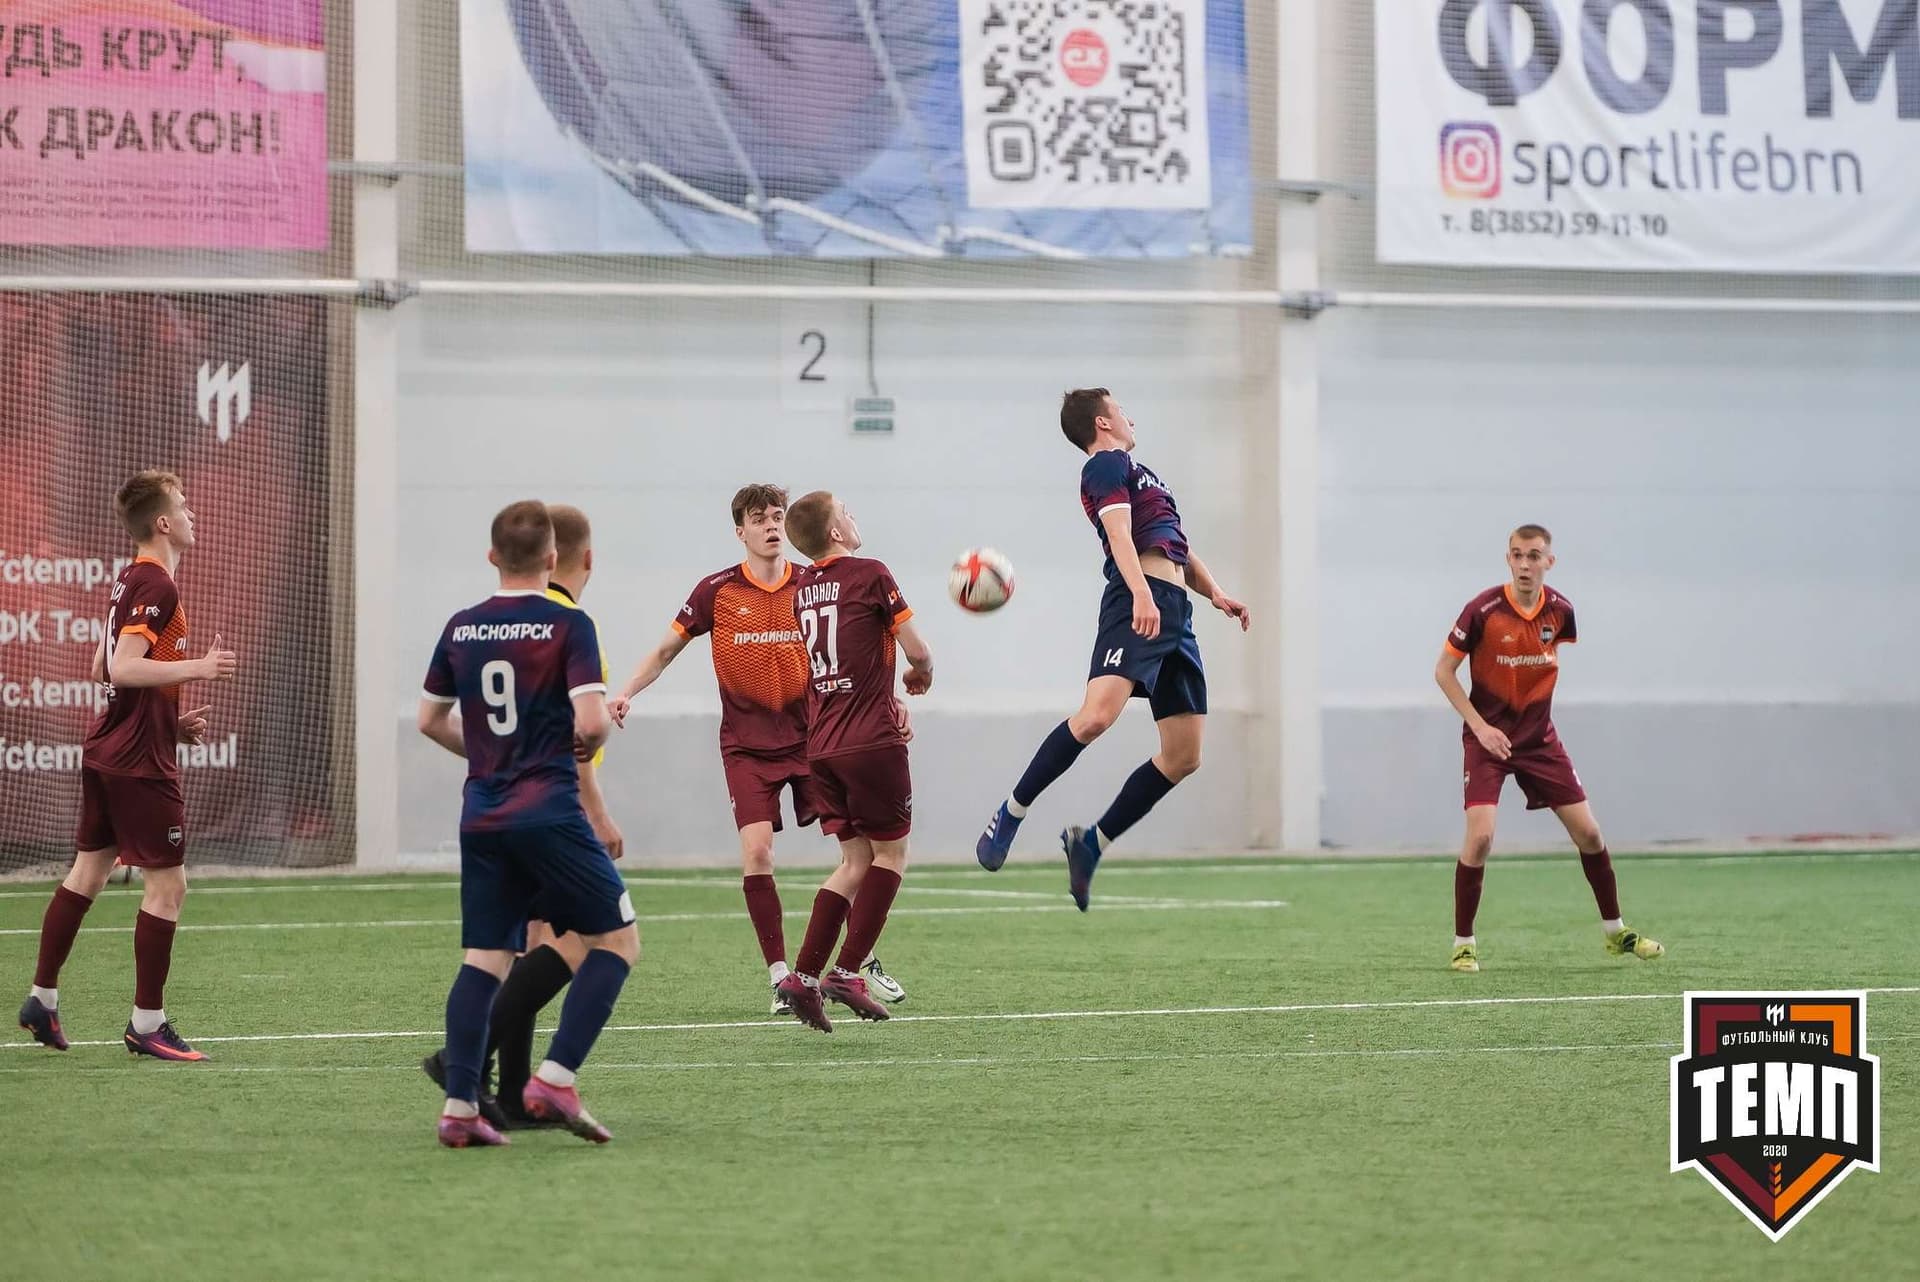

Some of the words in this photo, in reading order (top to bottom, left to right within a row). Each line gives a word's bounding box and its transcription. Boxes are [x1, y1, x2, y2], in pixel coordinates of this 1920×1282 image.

[0, 24, 82, 77] ДЬ
[1438, 0, 1920, 119] ФОРМ
[40, 106, 280, 160] ДРАКОН!
[1513, 131, 1863, 200] sportlifebrn
[1470, 209, 1564, 237] 8(3852)
[1571, 212, 1667, 236] 59-11-10
[799, 330, 827, 381] 2
[452, 623, 555, 642] КРАСНОЯРСК
[733, 630, 803, 645] ПРОДИНВЕ
[800, 604, 838, 679] 27
[1104, 648, 1123, 667] 14
[0, 673, 109, 714] c.temp
[481, 660, 518, 736] 9
